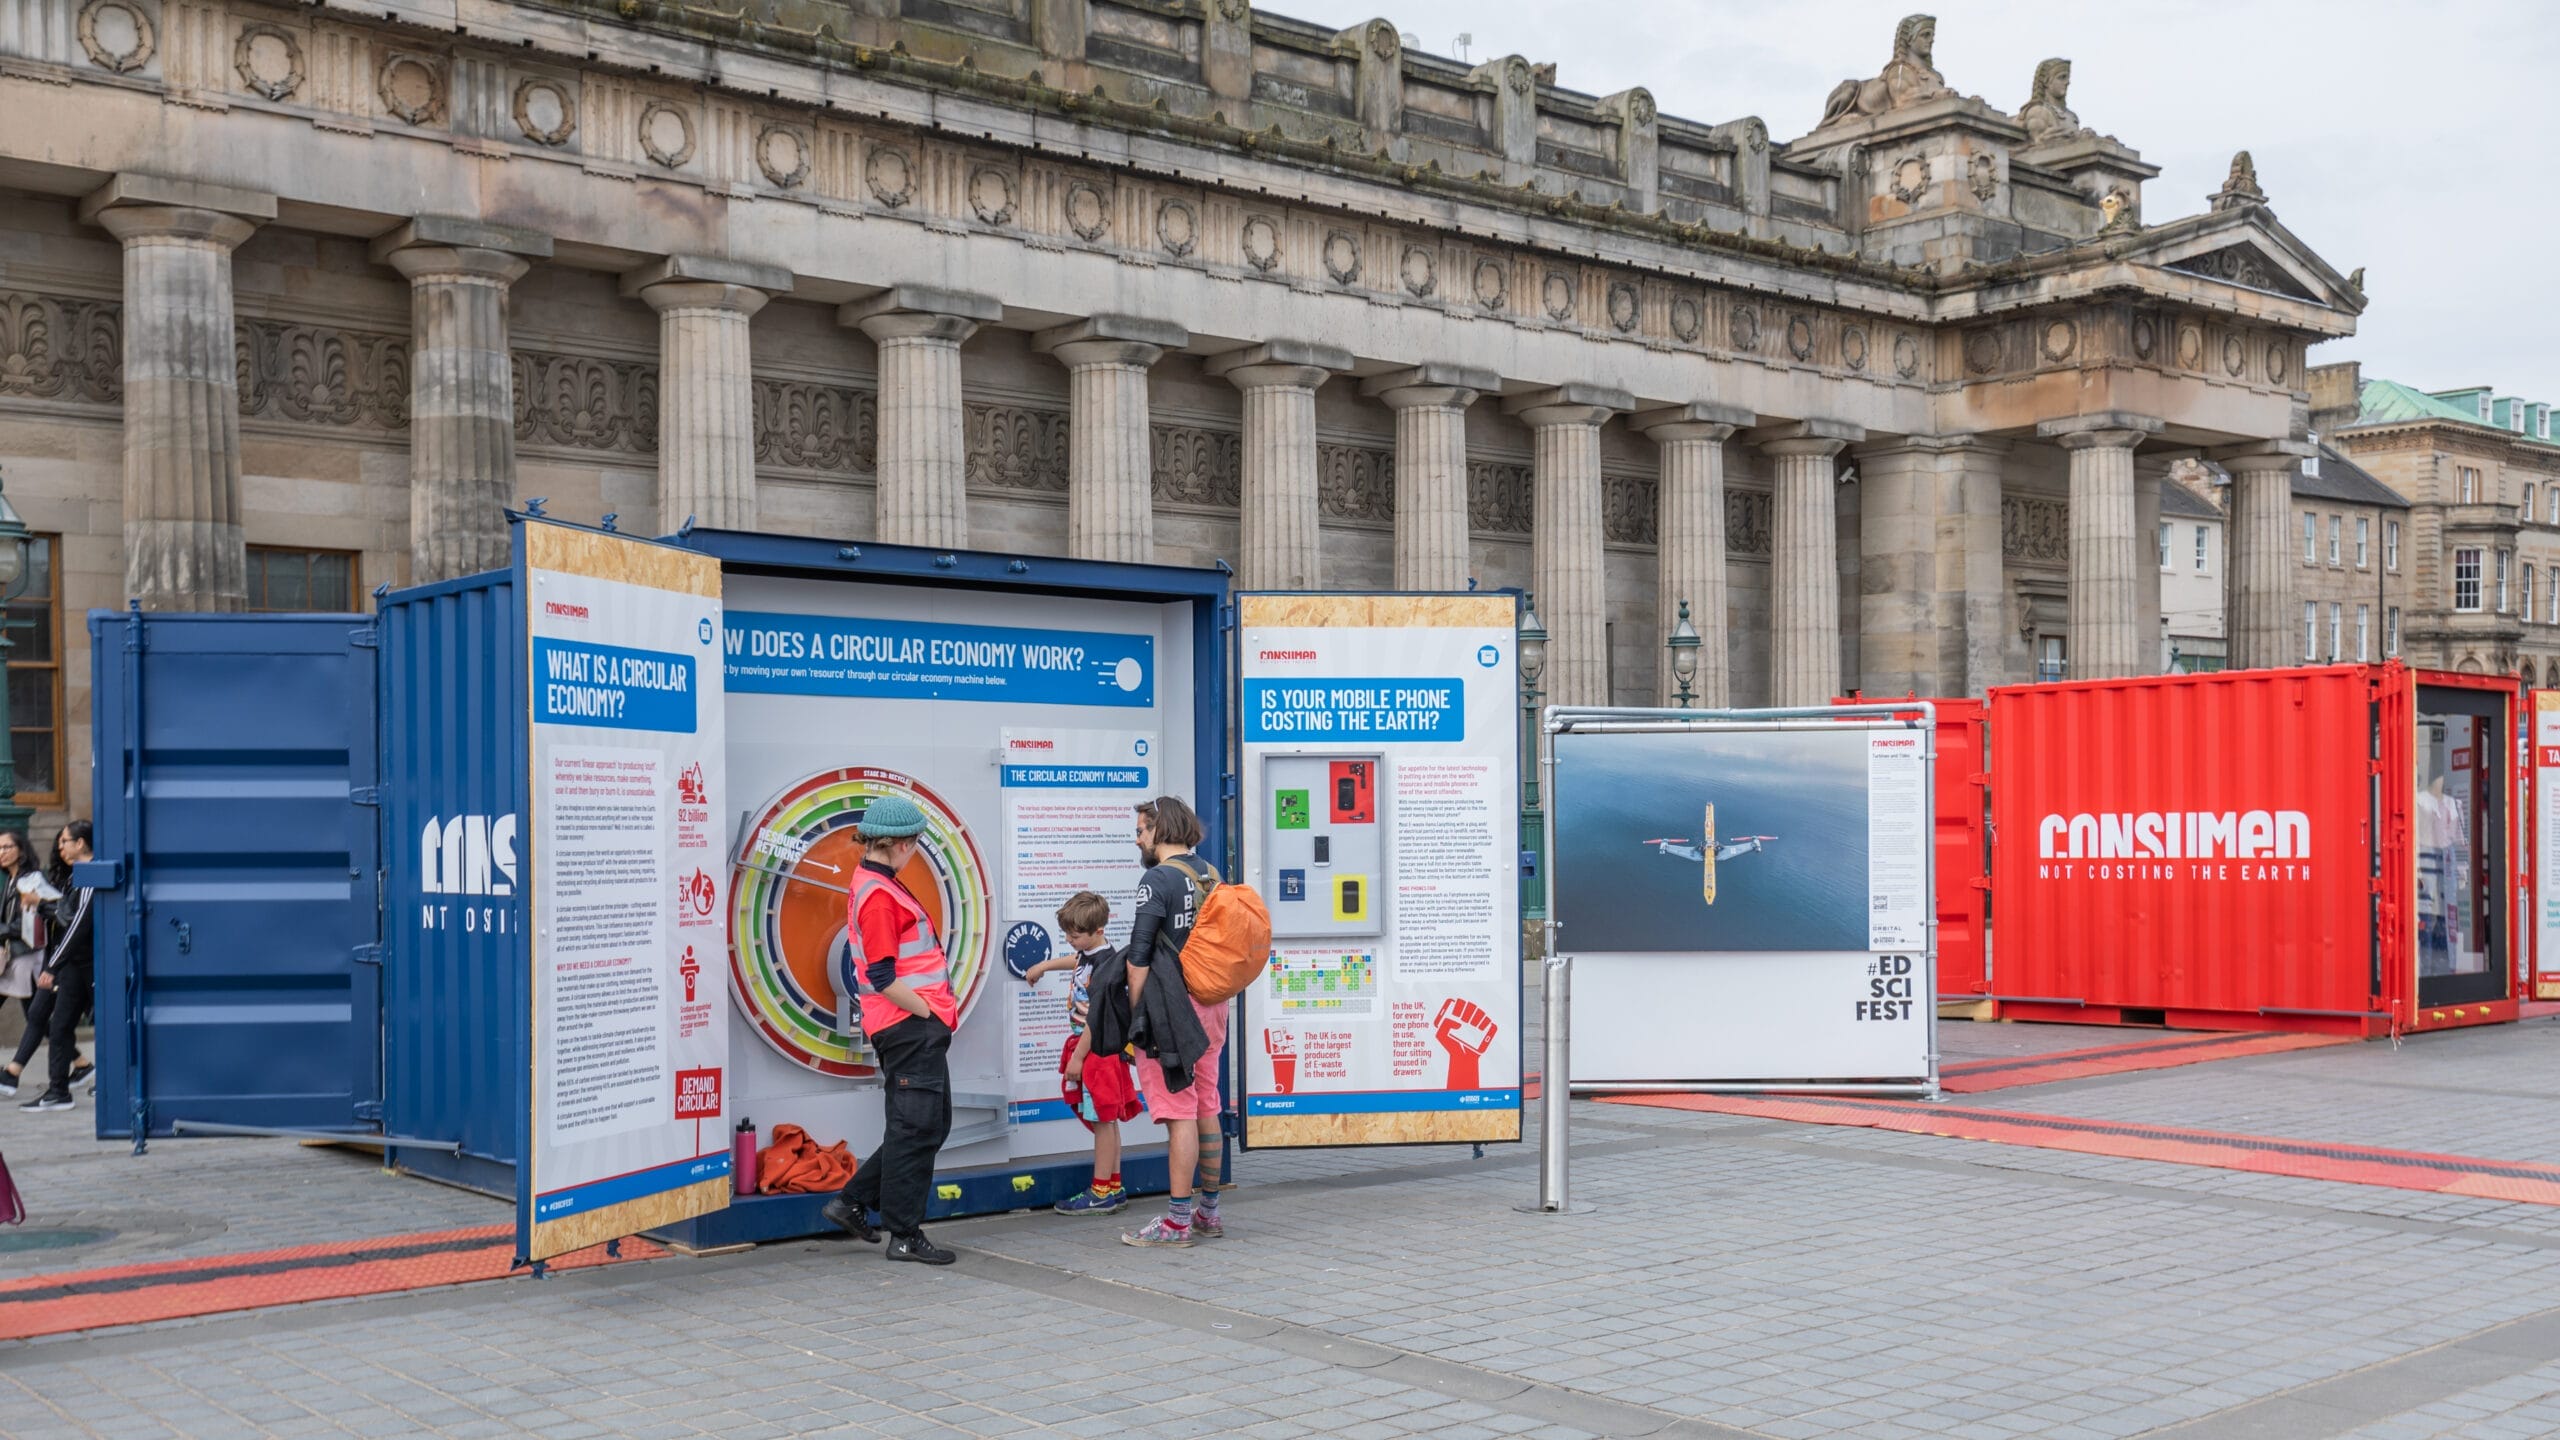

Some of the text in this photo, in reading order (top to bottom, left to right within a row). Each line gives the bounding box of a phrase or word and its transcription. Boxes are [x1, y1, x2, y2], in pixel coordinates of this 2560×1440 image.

[752, 630, 804, 658] DOES
[810, 633, 824, 659] A
[830, 634, 925, 664] CIRCULAR
[931, 640, 1016, 668] ECONOMY
[1022, 644, 1084, 671] WORK?
[546, 650, 687, 692] WHAT IS A CIRCULAR
[729, 664, 739, 677] by
[741, 665, 769, 678] moving
[771, 668, 789, 678] your
[791, 668, 806, 678] own
[847, 670, 876, 682] through
[877, 671, 890, 681] our
[891, 670, 919, 682] circular
[920, 674, 952, 686] economy
[954, 674, 984, 685] machine
[985, 675, 1007, 686] below.
[547, 685, 626, 719] ECONOMY?
[1261, 689, 1450, 709] IS YOUR MOBILE PHONE
[1261, 710, 1440, 731] COSTING THE EARTH?
[1408, 765, 1428, 773] appetite
[1461, 765, 1488, 773] technology
[1011, 770, 1140, 784] THE CIRCULAR ECONOMY MACHINE
[1404, 773, 1421, 781] putting
[1451, 781, 1468, 789] phones
[679, 808, 708, 822] 92 billion
[759, 828, 809, 852] RESOURCE
[756, 839, 800, 863] RETURNS
[2040, 864, 2310, 880] NOT COSTING THE EARTH
[1007, 924, 1044, 949] TURN ME
[1866, 955, 1912, 976] #ED
[1870, 978, 1911, 998] SCI
[1392, 1002, 1399, 1010] In
[1401, 1002, 1412, 1010] the
[1856, 1000, 1912, 1021] FEST
[1393, 1012, 1403, 1020] for
[1408, 1021, 1429, 1030] phone
[1304, 1031, 1317, 1040] The
[1320, 1031, 1328, 1040] UK
[1331, 1031, 1337, 1040] is
[1393, 1030, 1399, 1038] in
[1304, 1041, 1351, 1051] of the largest
[1393, 1040, 1412, 1048] there
[1304, 1051, 1341, 1061] producers
[1393, 1049, 1432, 1058] four sitting
[1304, 1060, 1342, 1068] of E-waste
[1420, 1058, 1427, 1066] in
[1304, 1069, 1346, 1078] in the world
[1393, 1068, 1422, 1076] drawers
[682, 1076, 715, 1095] DEMAND
[677, 1093, 718, 1112] CIRCULAR!
